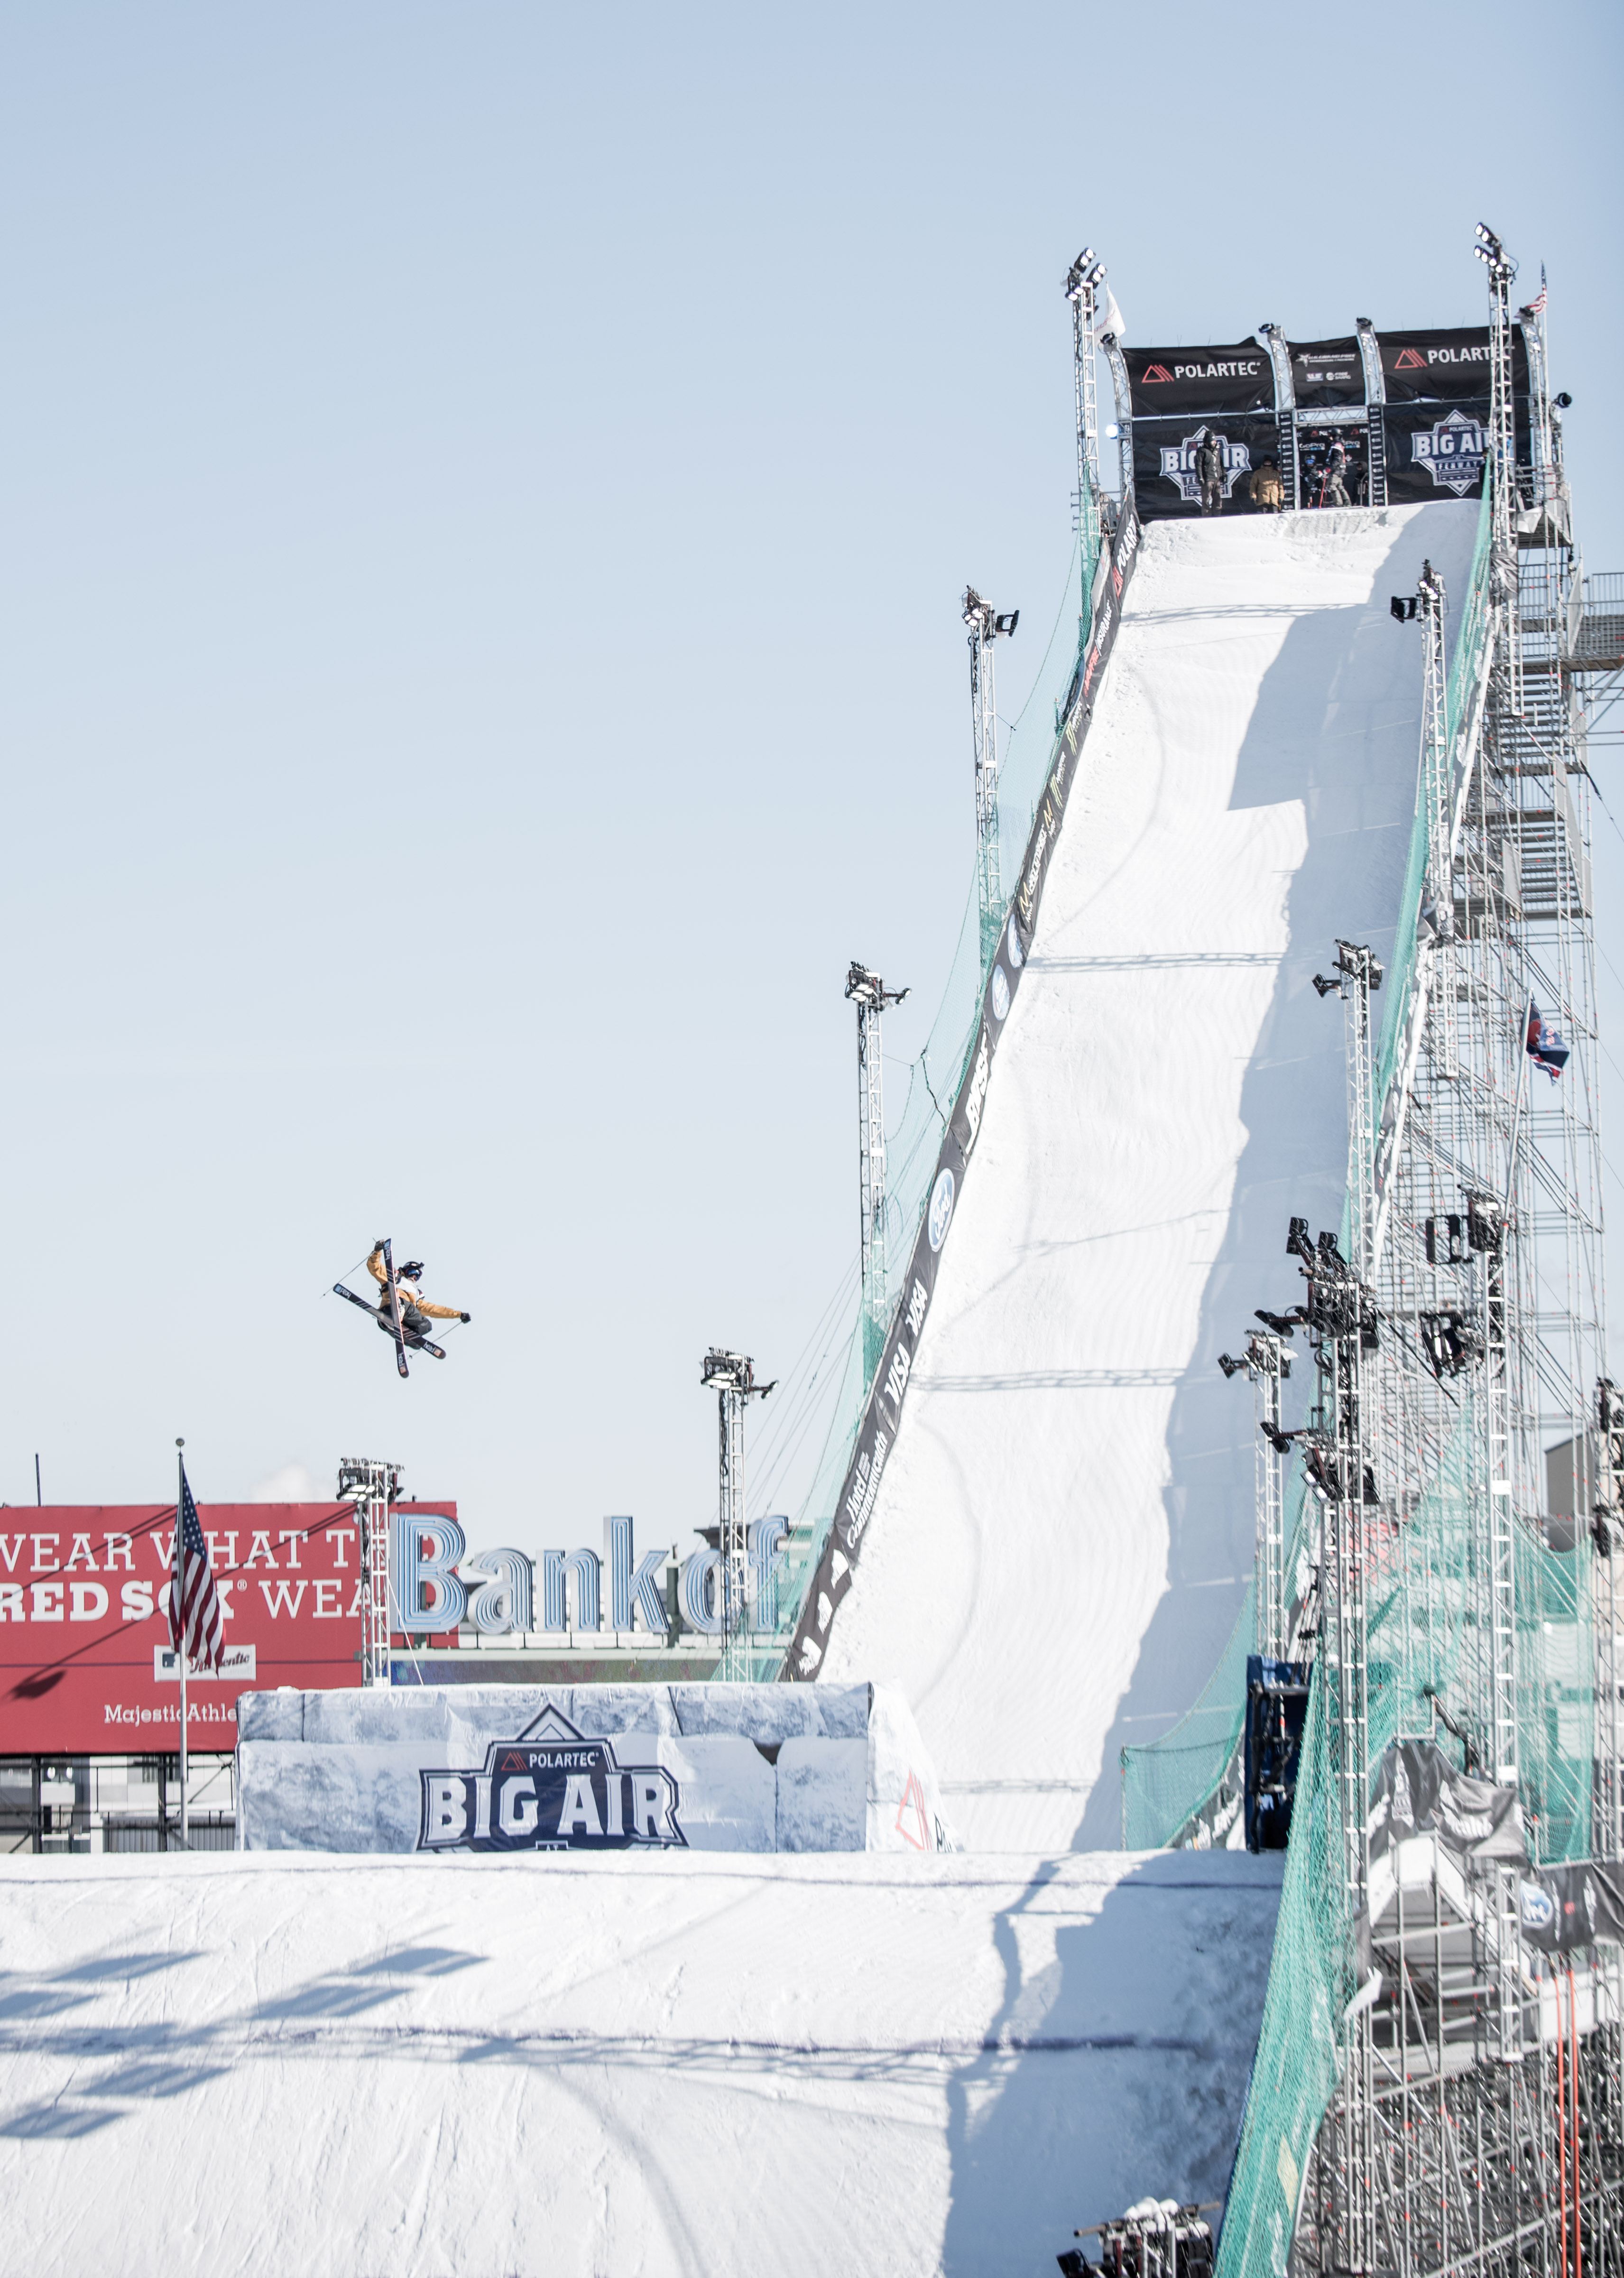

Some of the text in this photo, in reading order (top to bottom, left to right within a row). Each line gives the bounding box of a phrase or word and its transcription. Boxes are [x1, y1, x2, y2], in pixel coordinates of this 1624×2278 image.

[1174, 362, 1257, 378] POLARTEC
[1223, 448, 1246, 468] IR
[1416, 432, 1490, 457] BIG AI
[934, 1183, 950, 1238] Ford
[905, 1278, 928, 1337] VISA
[884, 1342, 911, 1406] VISA
[846, 1468, 867, 1524] Hotel
[0, 1582, 109, 1622] RED
[258, 1578, 378, 1619] WEA
[390, 1513, 788, 1635] Bank of
[529, 1751, 596, 1769] POLARTEC
[428, 1772, 675, 1840] BIG AIR
